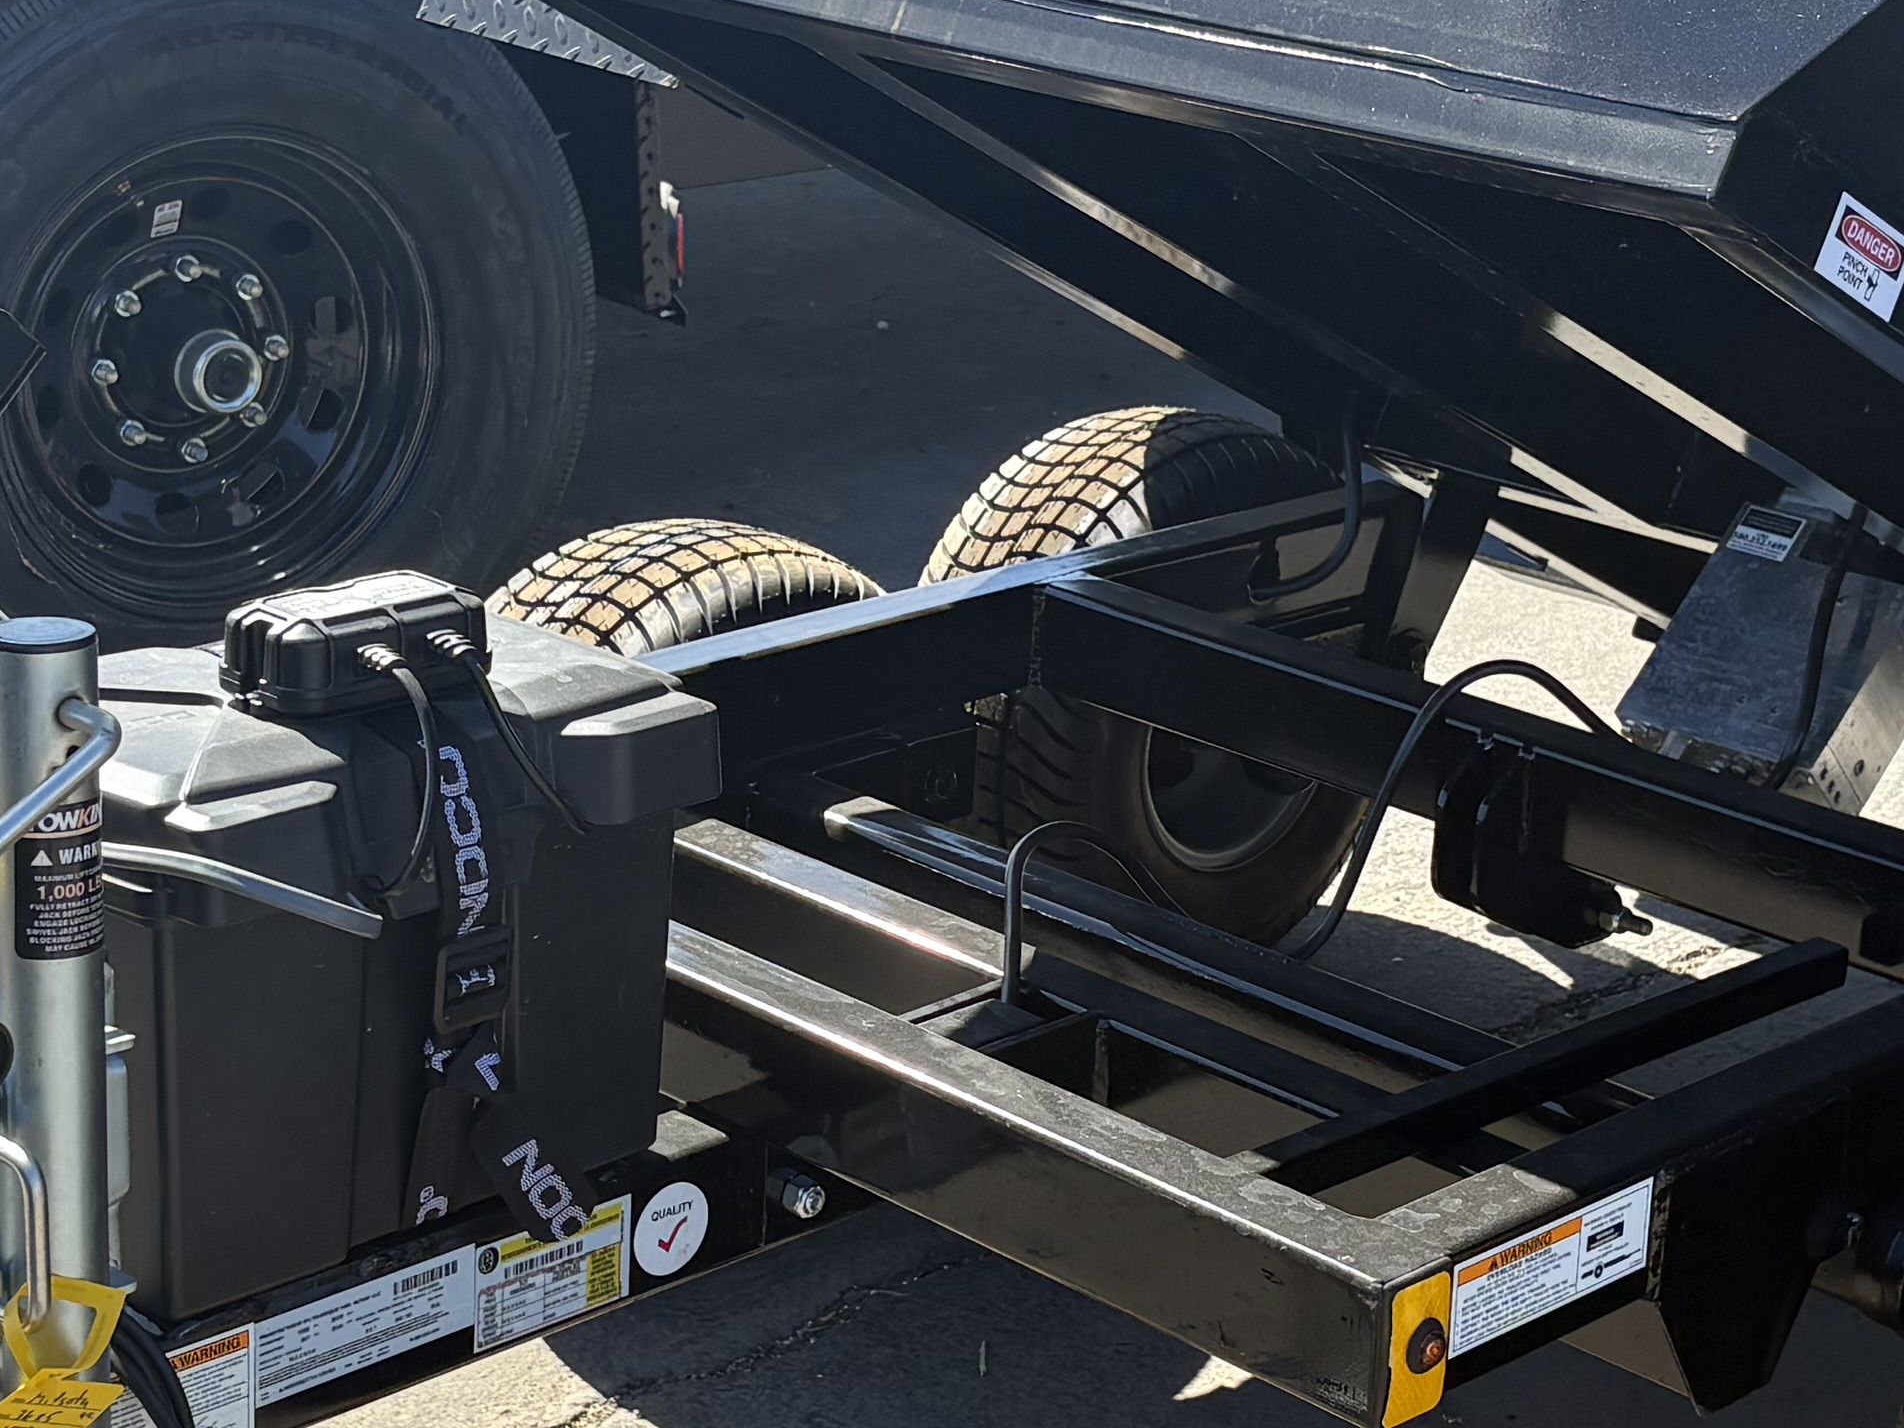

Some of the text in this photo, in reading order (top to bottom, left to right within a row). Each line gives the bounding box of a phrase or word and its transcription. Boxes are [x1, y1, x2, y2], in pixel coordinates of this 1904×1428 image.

[1847, 221, 1894, 267] DANGER
[1837, 266, 1863, 290] POINT
[1842, 252, 1868, 278] PINCH
[36, 884, 85, 902] 1,000
[651, 1198, 694, 1223] QUALITY
[1498, 1232, 1553, 1266] WARNING
[177, 1336, 242, 1369] WARNING
